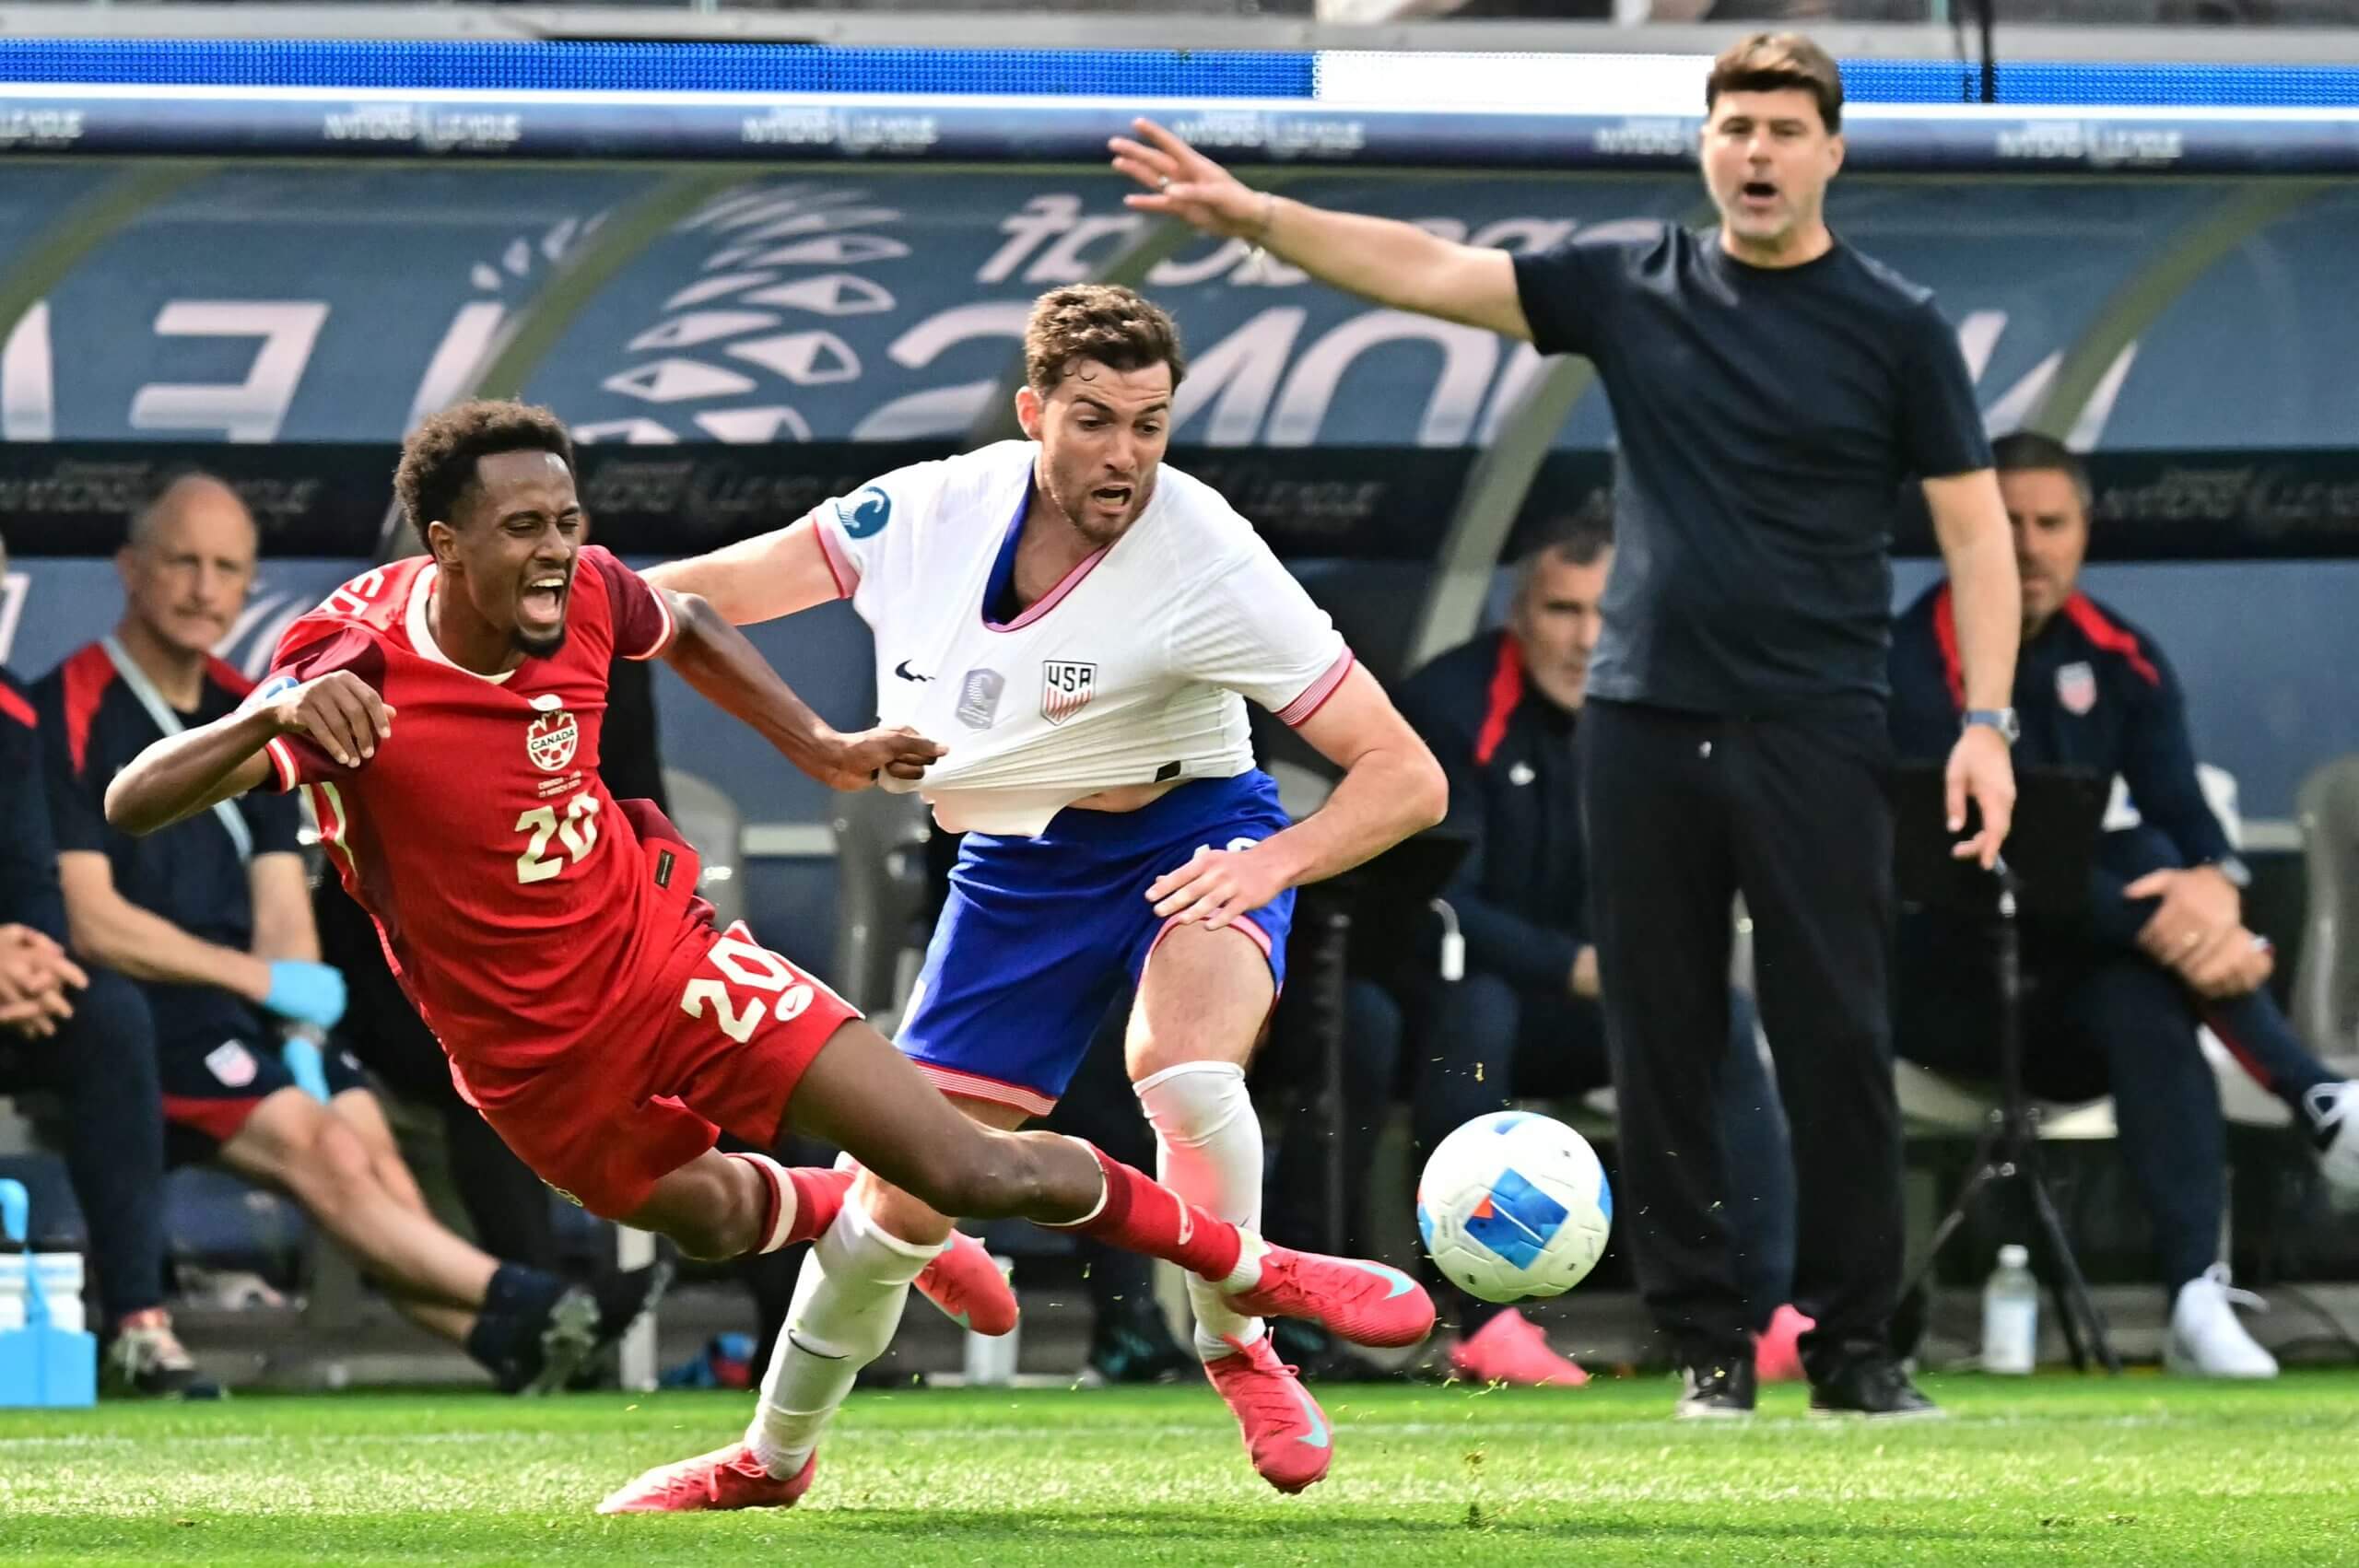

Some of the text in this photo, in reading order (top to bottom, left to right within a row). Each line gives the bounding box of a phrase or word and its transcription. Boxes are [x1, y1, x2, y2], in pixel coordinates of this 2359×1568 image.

[1048, 664, 1092, 693] USA
[531, 729, 575, 751] CANADA
[514, 790, 600, 884] 20
[680, 936, 795, 1044] 20
